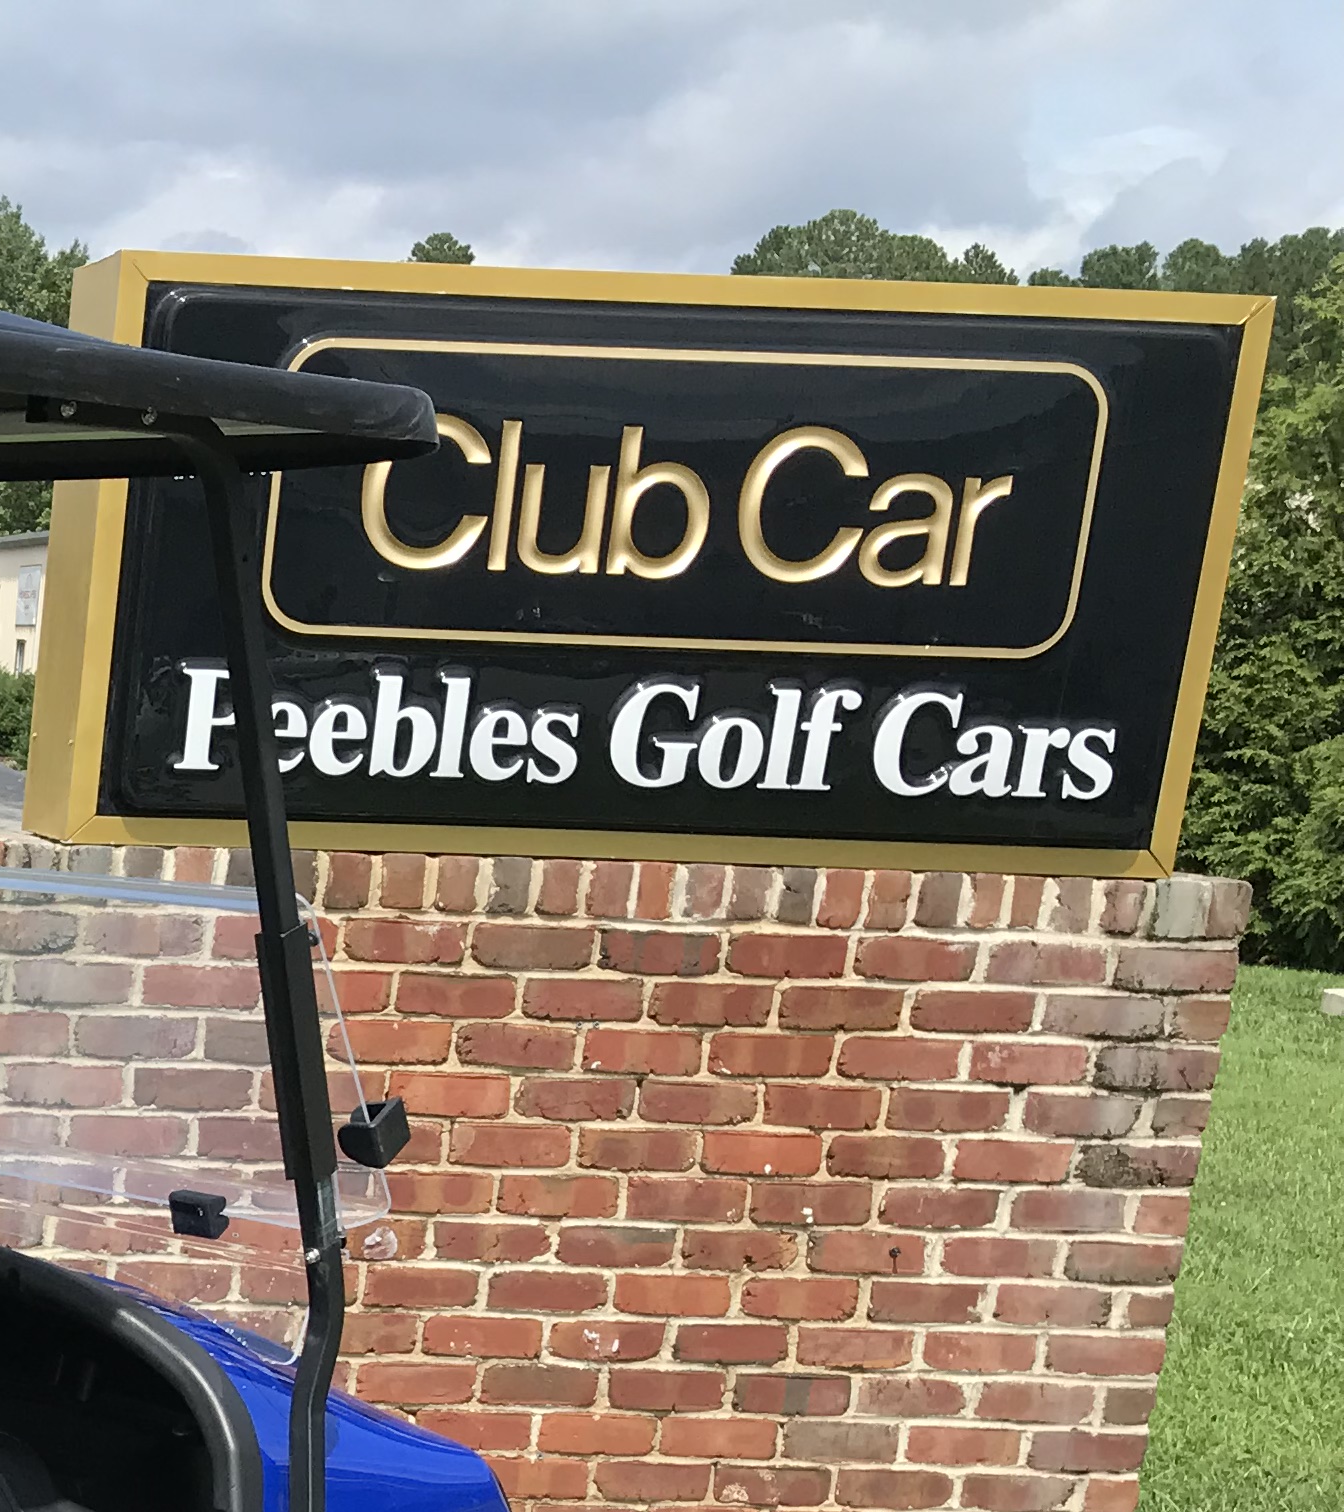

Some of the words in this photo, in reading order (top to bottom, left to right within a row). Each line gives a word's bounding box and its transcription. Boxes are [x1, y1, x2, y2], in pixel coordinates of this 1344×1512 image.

[362, 413, 710, 579] Club
[739, 426, 1012, 586] Car
[610, 682, 863, 791] Golf
[873, 691, 1116, 800] Cars
